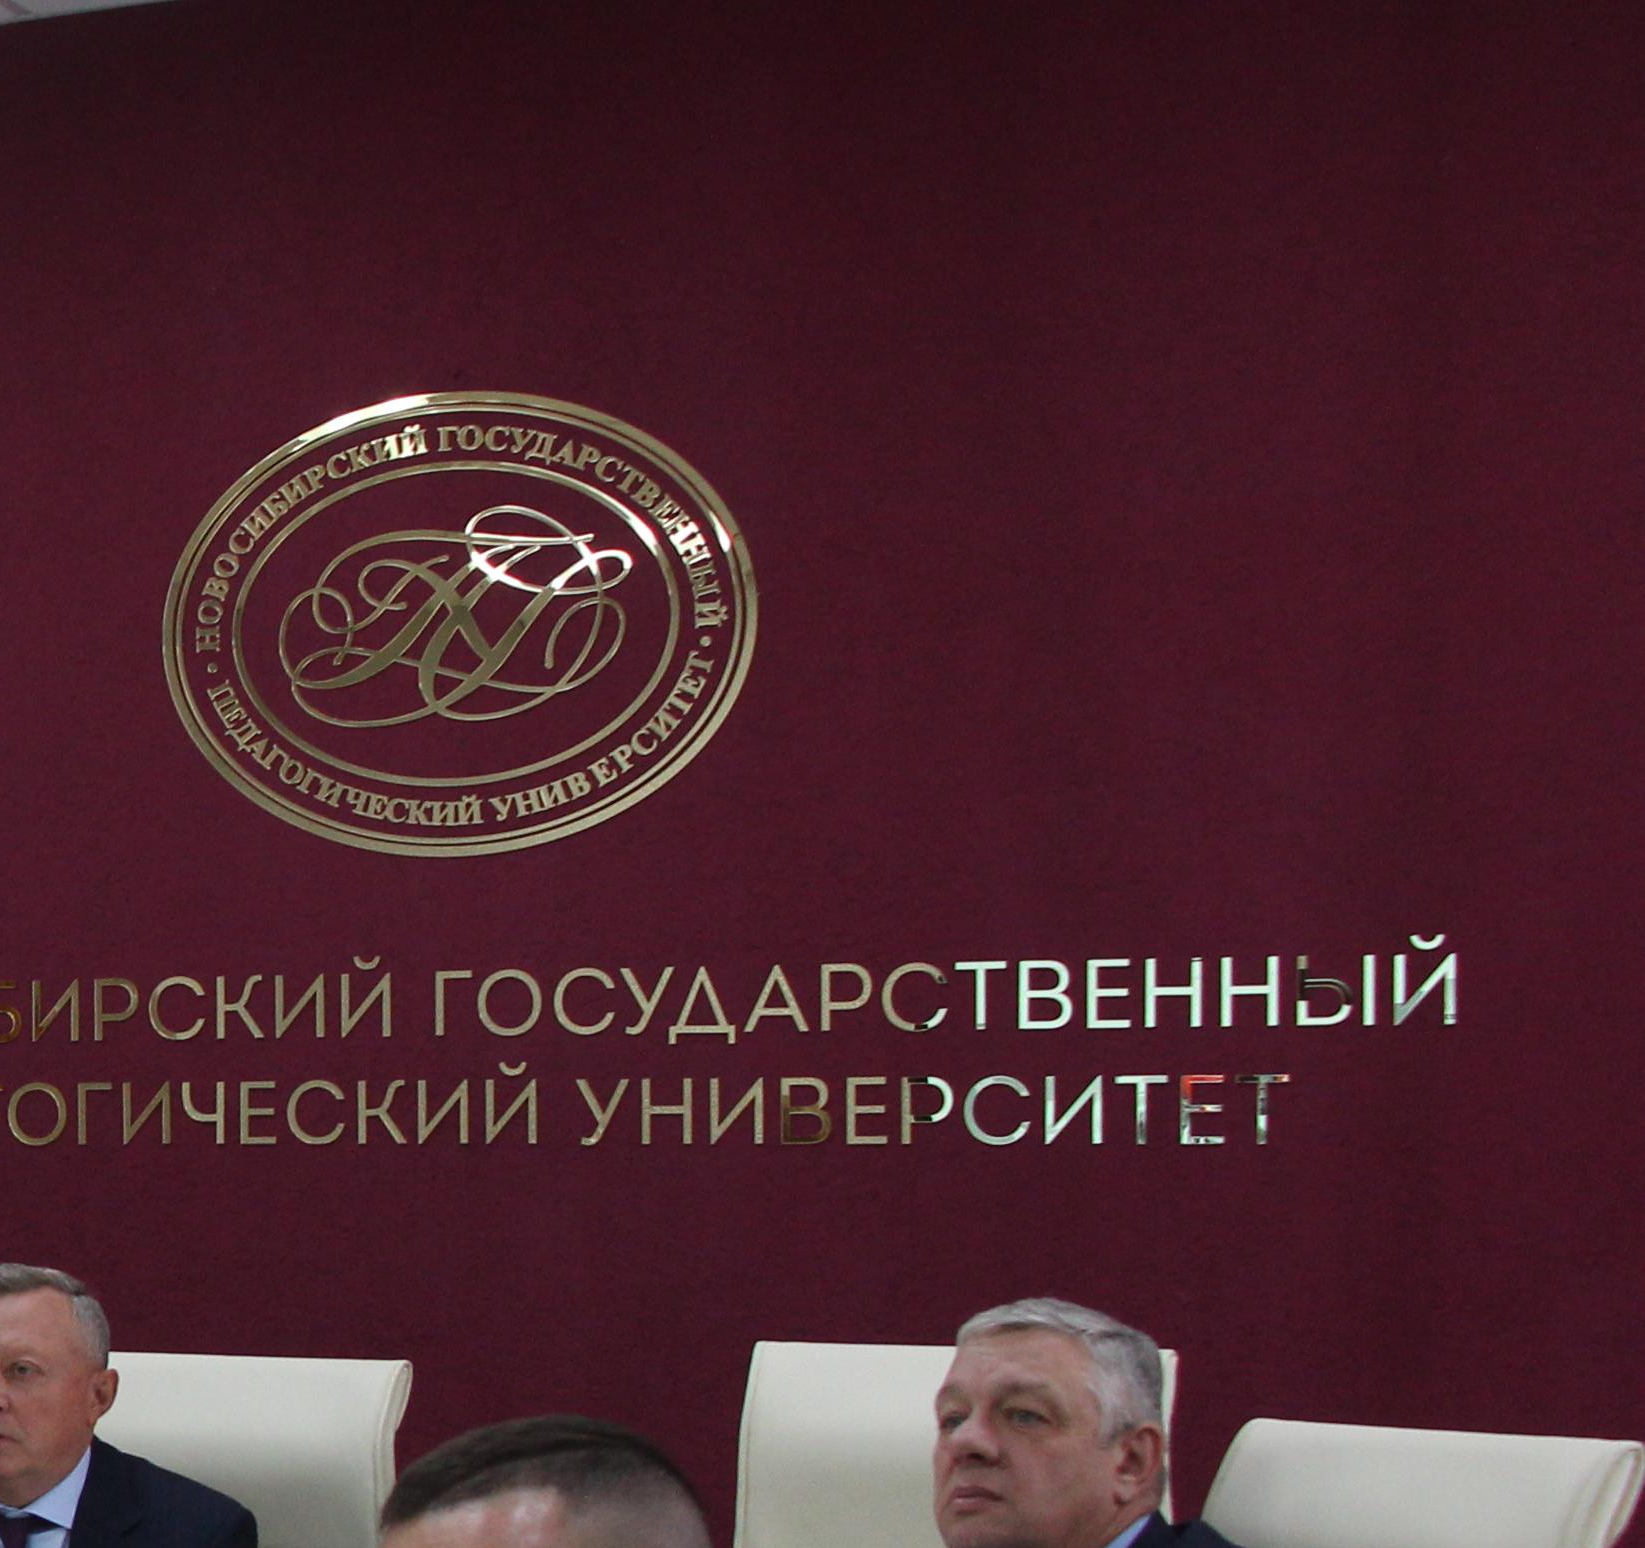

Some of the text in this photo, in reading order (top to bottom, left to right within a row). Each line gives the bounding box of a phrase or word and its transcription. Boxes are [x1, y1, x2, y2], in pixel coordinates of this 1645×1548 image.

[196, 424, 428, 654] НОВОСИБИРСКИЙ
[438, 424, 728, 630] ГОСУДАРСТВЕННЫЙ
[208, 651, 714, 826] ПЕДАГОГИЧЕСКИЙ УНИВЕРСИТЕТ
[434, 933, 1458, 1045] ГОСУДАРСТВЕННЫЙ
[575, 1073, 1291, 1147] УНИВЕРСИТЕТ
